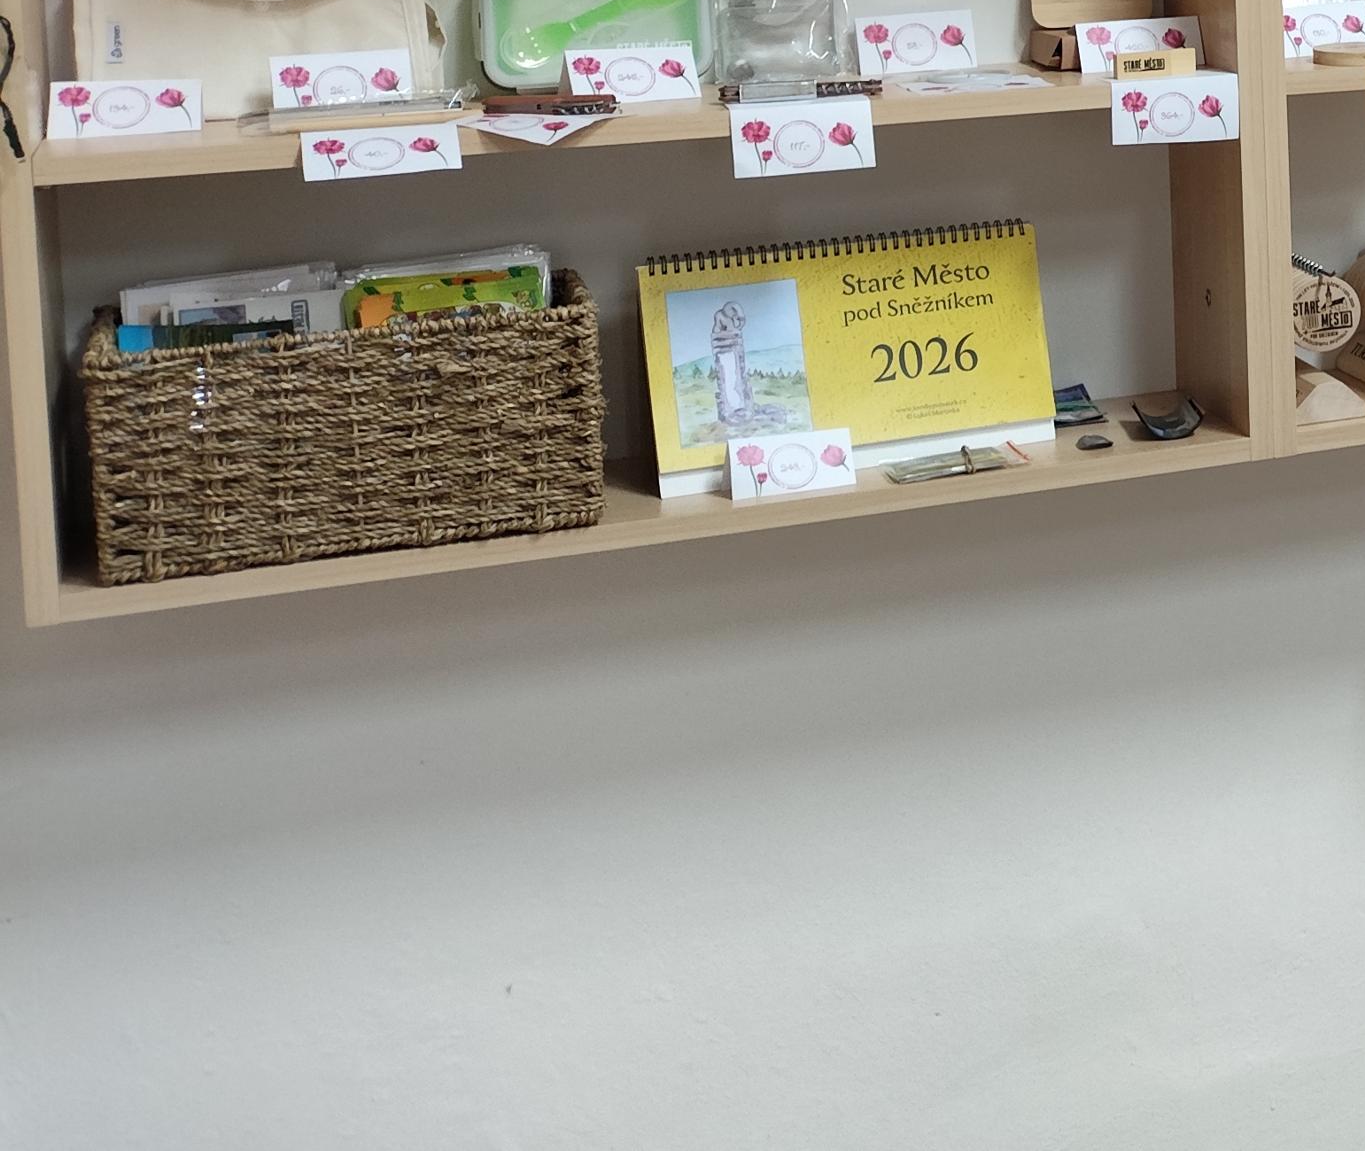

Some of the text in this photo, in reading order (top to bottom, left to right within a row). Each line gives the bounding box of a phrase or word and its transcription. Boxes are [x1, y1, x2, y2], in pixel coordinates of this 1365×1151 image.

[114, 25, 122, 47] green
[842, 263, 990, 296] Staré Město
[843, 292, 994, 327] pod Sněžníkem
[1293, 297, 1321, 317] STARÉ
[1321, 310, 1350, 328] MĚSTO
[870, 332, 978, 383] 2026
